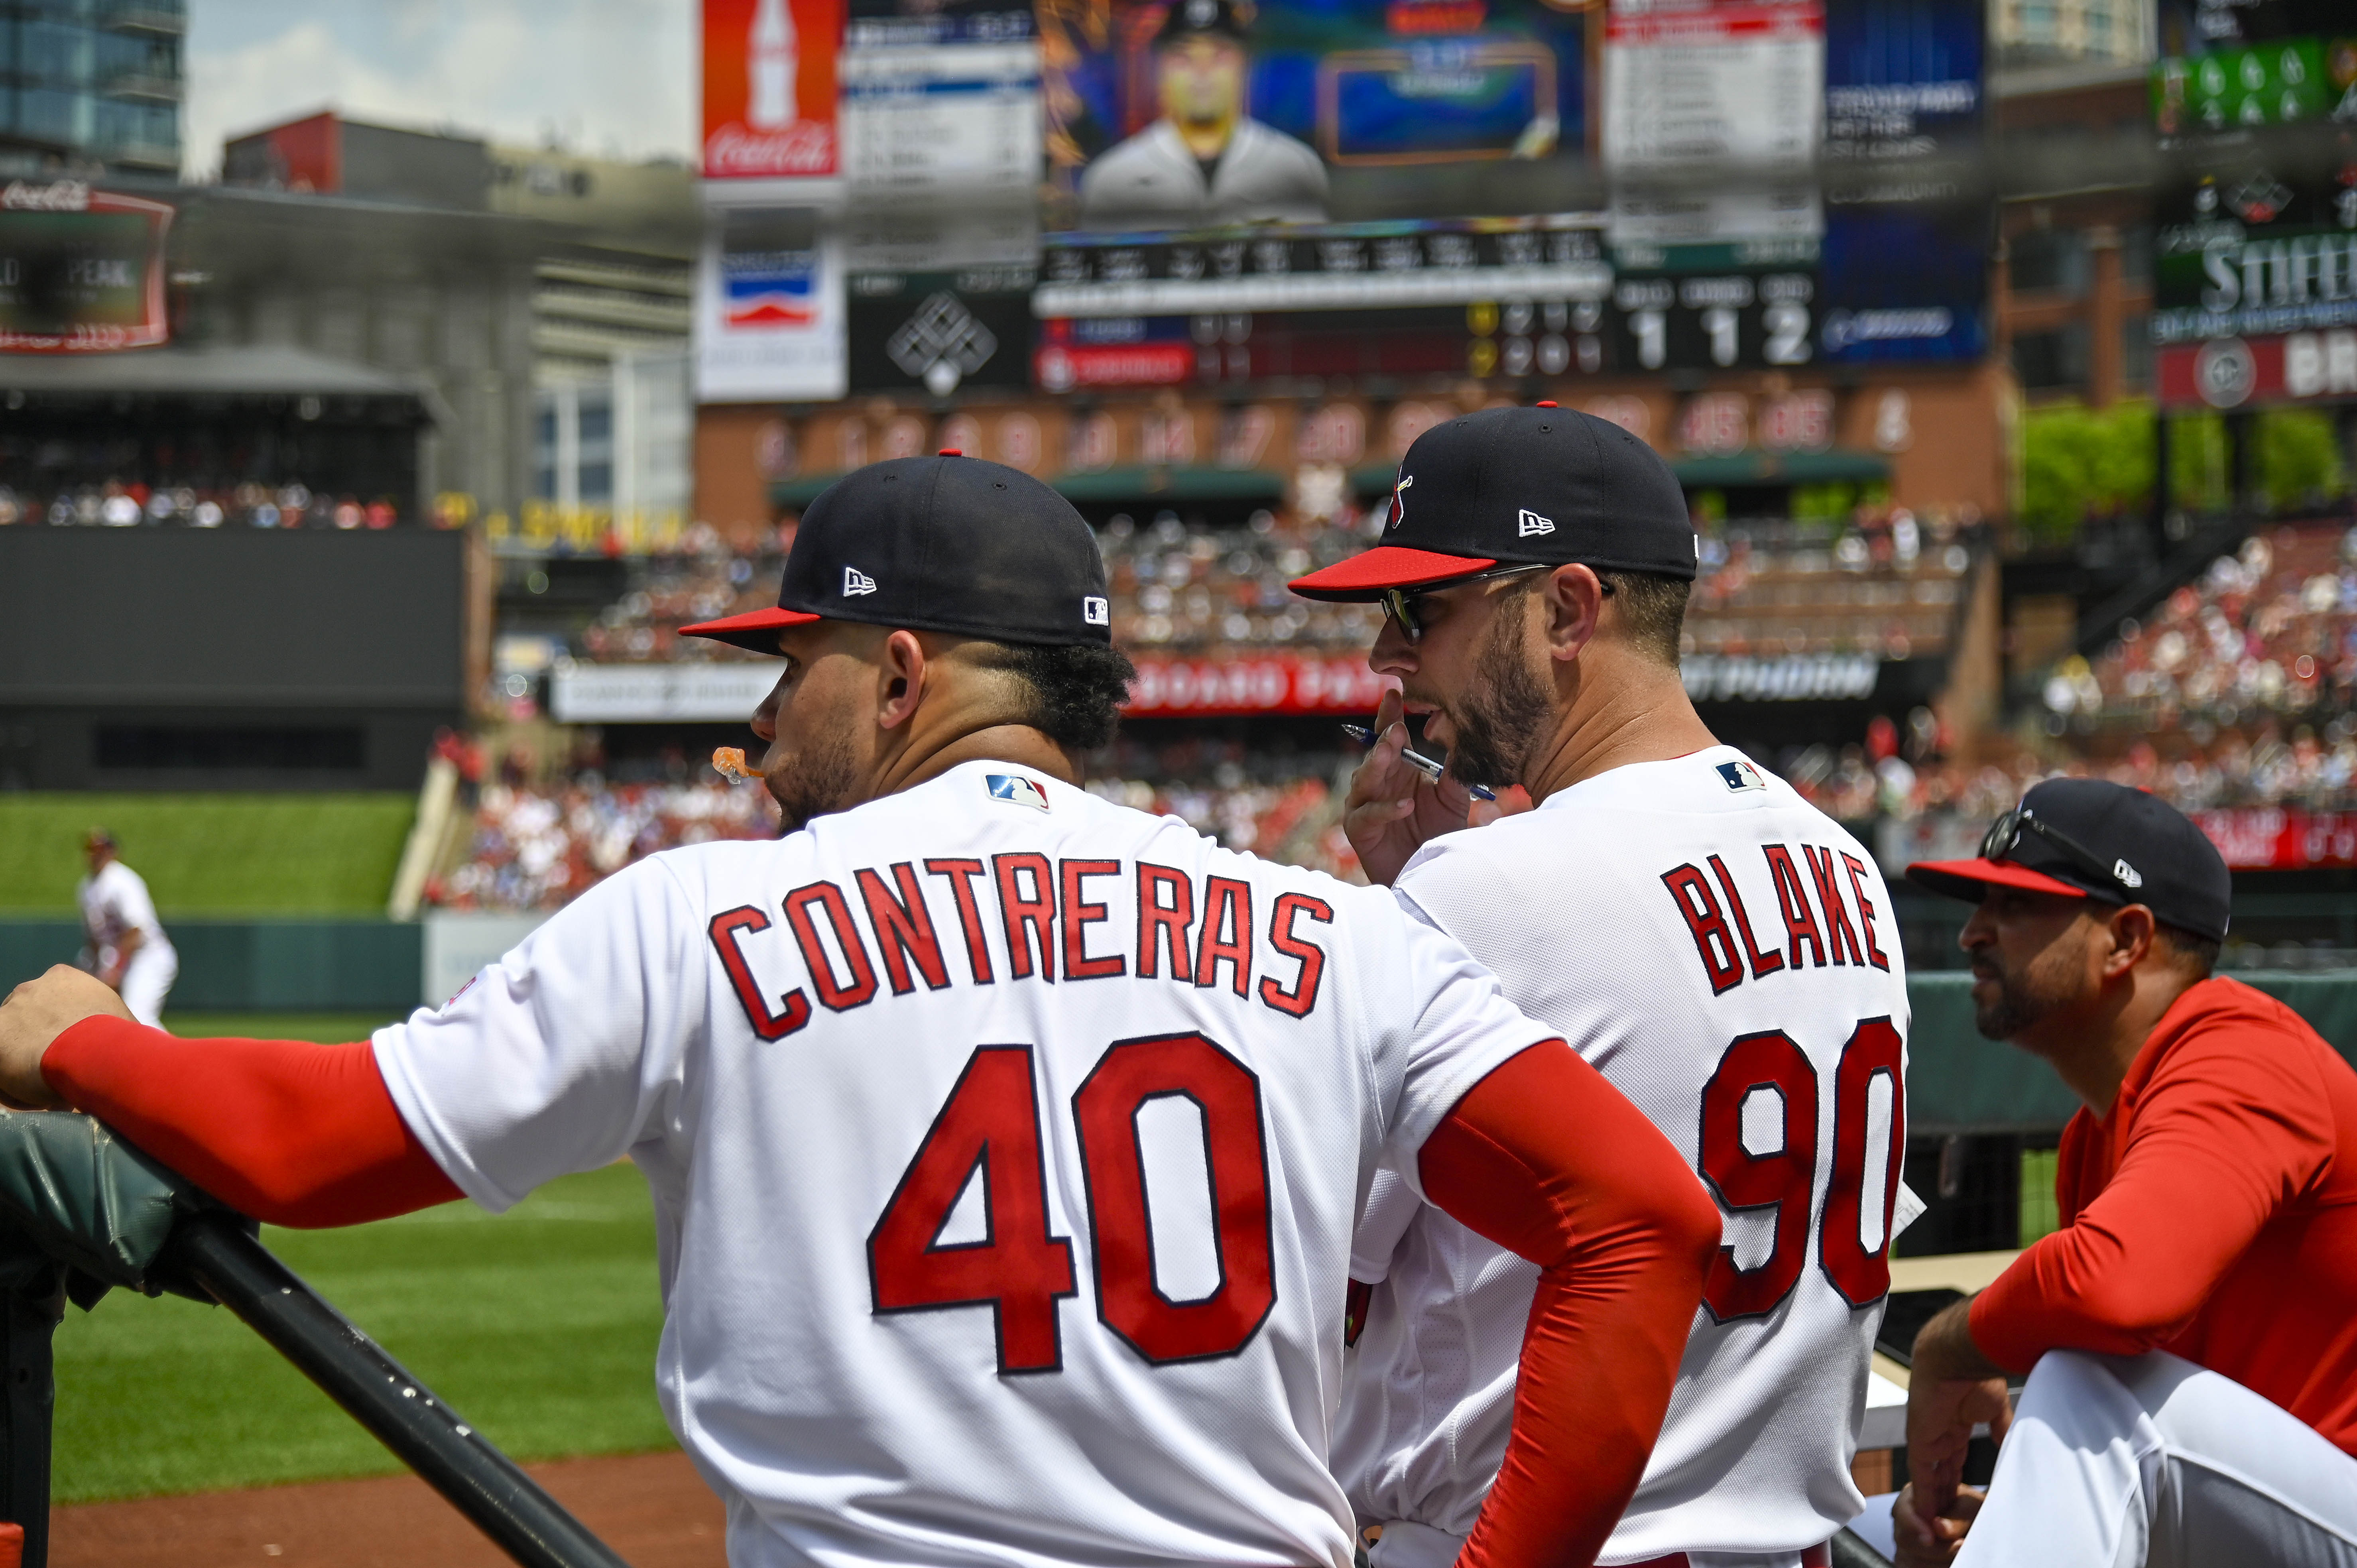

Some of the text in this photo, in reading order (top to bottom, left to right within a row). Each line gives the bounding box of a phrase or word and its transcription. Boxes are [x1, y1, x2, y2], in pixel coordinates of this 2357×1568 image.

[1627, 309, 1666, 370] 1
[1700, 307, 1739, 367] 1
[1762, 304, 1813, 365] 2
[708, 852, 1333, 1043] CONTRERAS
[1661, 843, 1890, 996] BLAKE
[866, 1031, 1277, 1375] 40
[1698, 1015, 1902, 1326] 90
